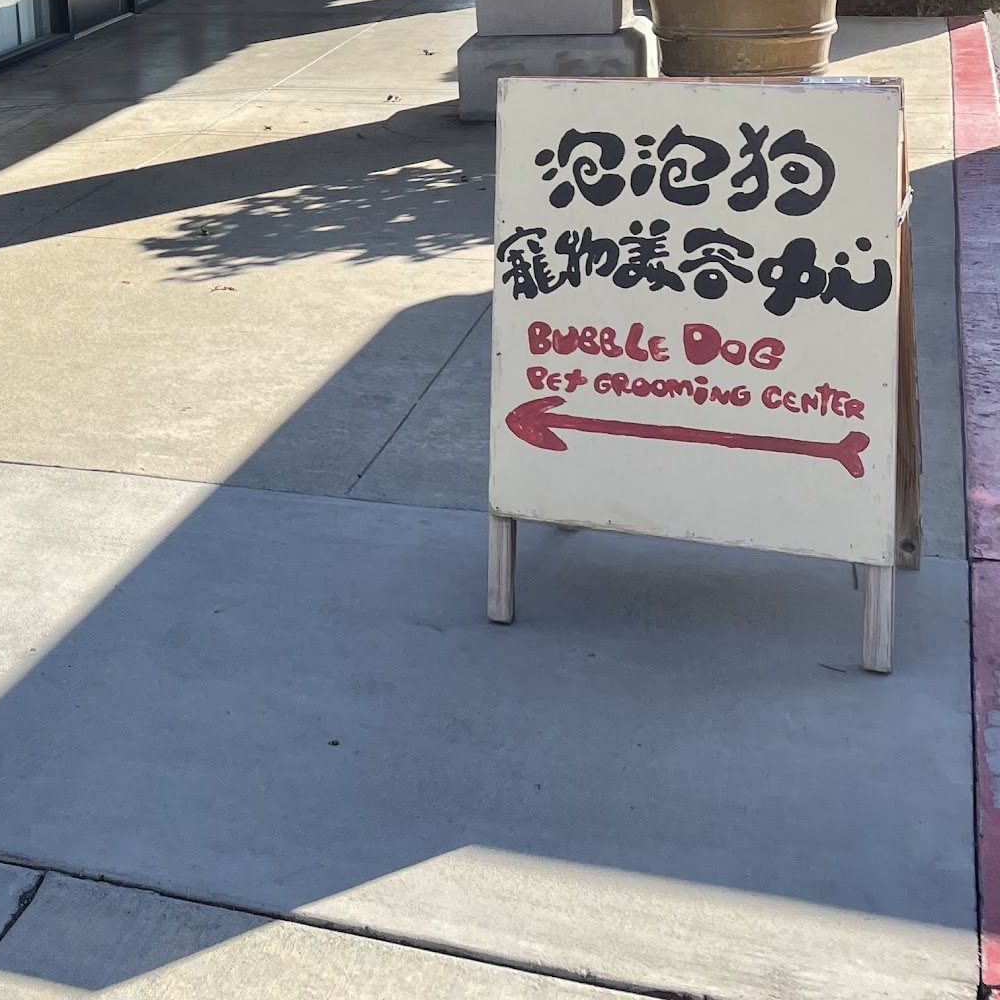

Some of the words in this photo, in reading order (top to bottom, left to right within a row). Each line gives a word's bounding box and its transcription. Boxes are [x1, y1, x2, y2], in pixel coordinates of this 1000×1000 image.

[535, 122, 836, 216] 泡泡狗
[496, 219, 893, 316] 寵物美容中心
[527, 321, 670, 362] BUBBLE
[683, 323, 786, 370] DOG
[760, 381, 865, 420] CENTER
